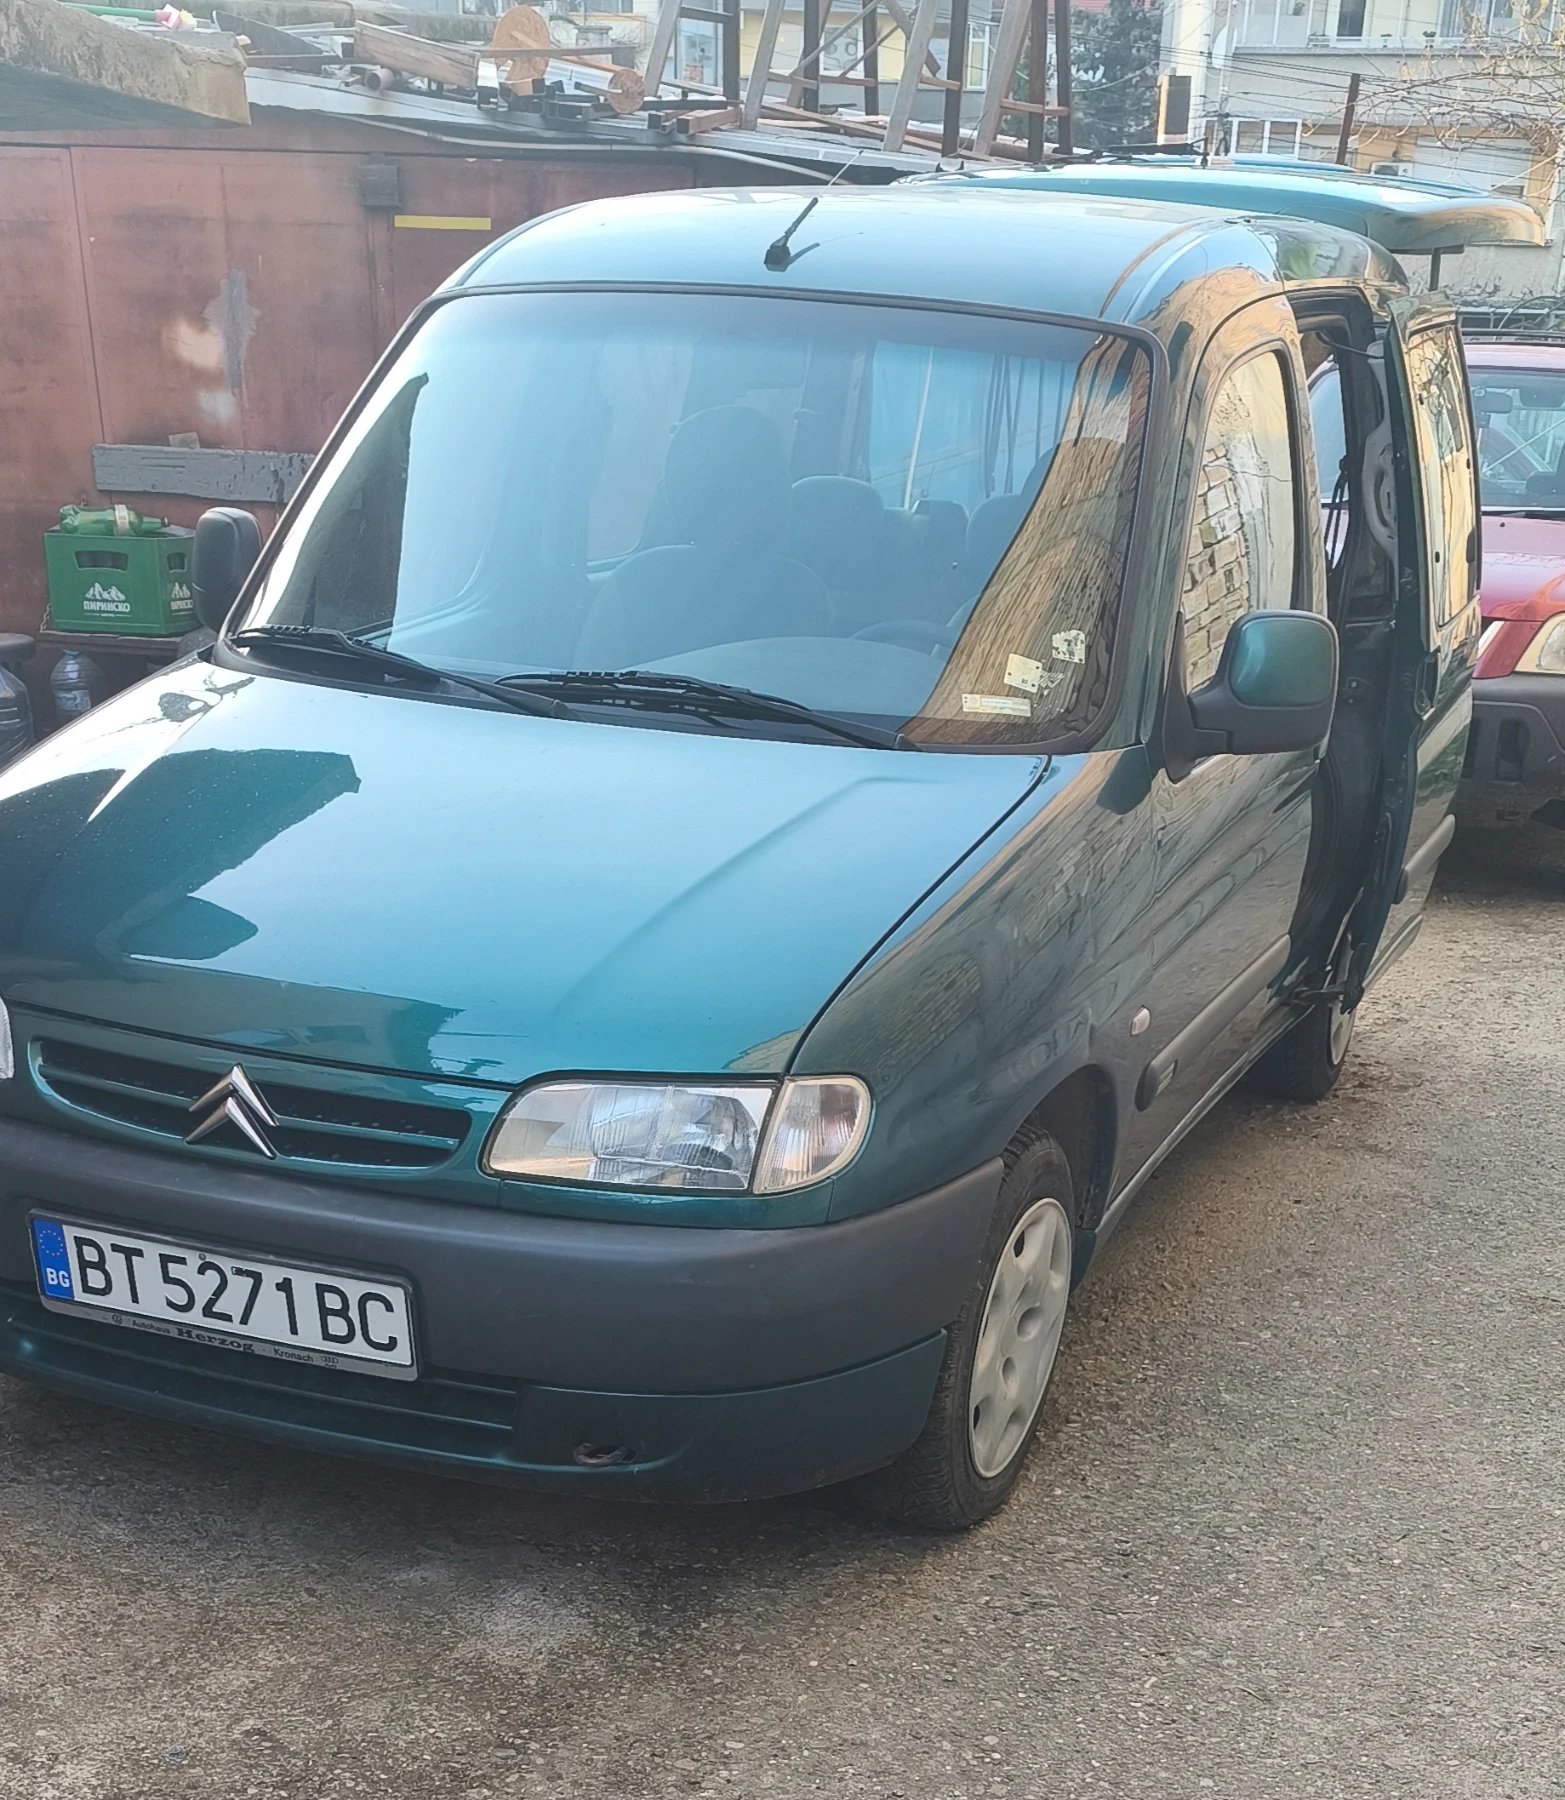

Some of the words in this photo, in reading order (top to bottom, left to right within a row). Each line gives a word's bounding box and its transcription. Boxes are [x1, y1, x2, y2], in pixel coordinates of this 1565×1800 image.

[83, 600, 131, 612] ПИРИНСКО
[46, 1267, 70, 1289] BG
[73, 1235, 145, 1304] BT
[158, 1252, 299, 1336] 5271
[314, 1282, 398, 1352] BC
[132, 1319, 171, 1334] Autohaus
[176, 1326, 255, 1354] Herzog
[273, 1347, 314, 1363] Kronach
